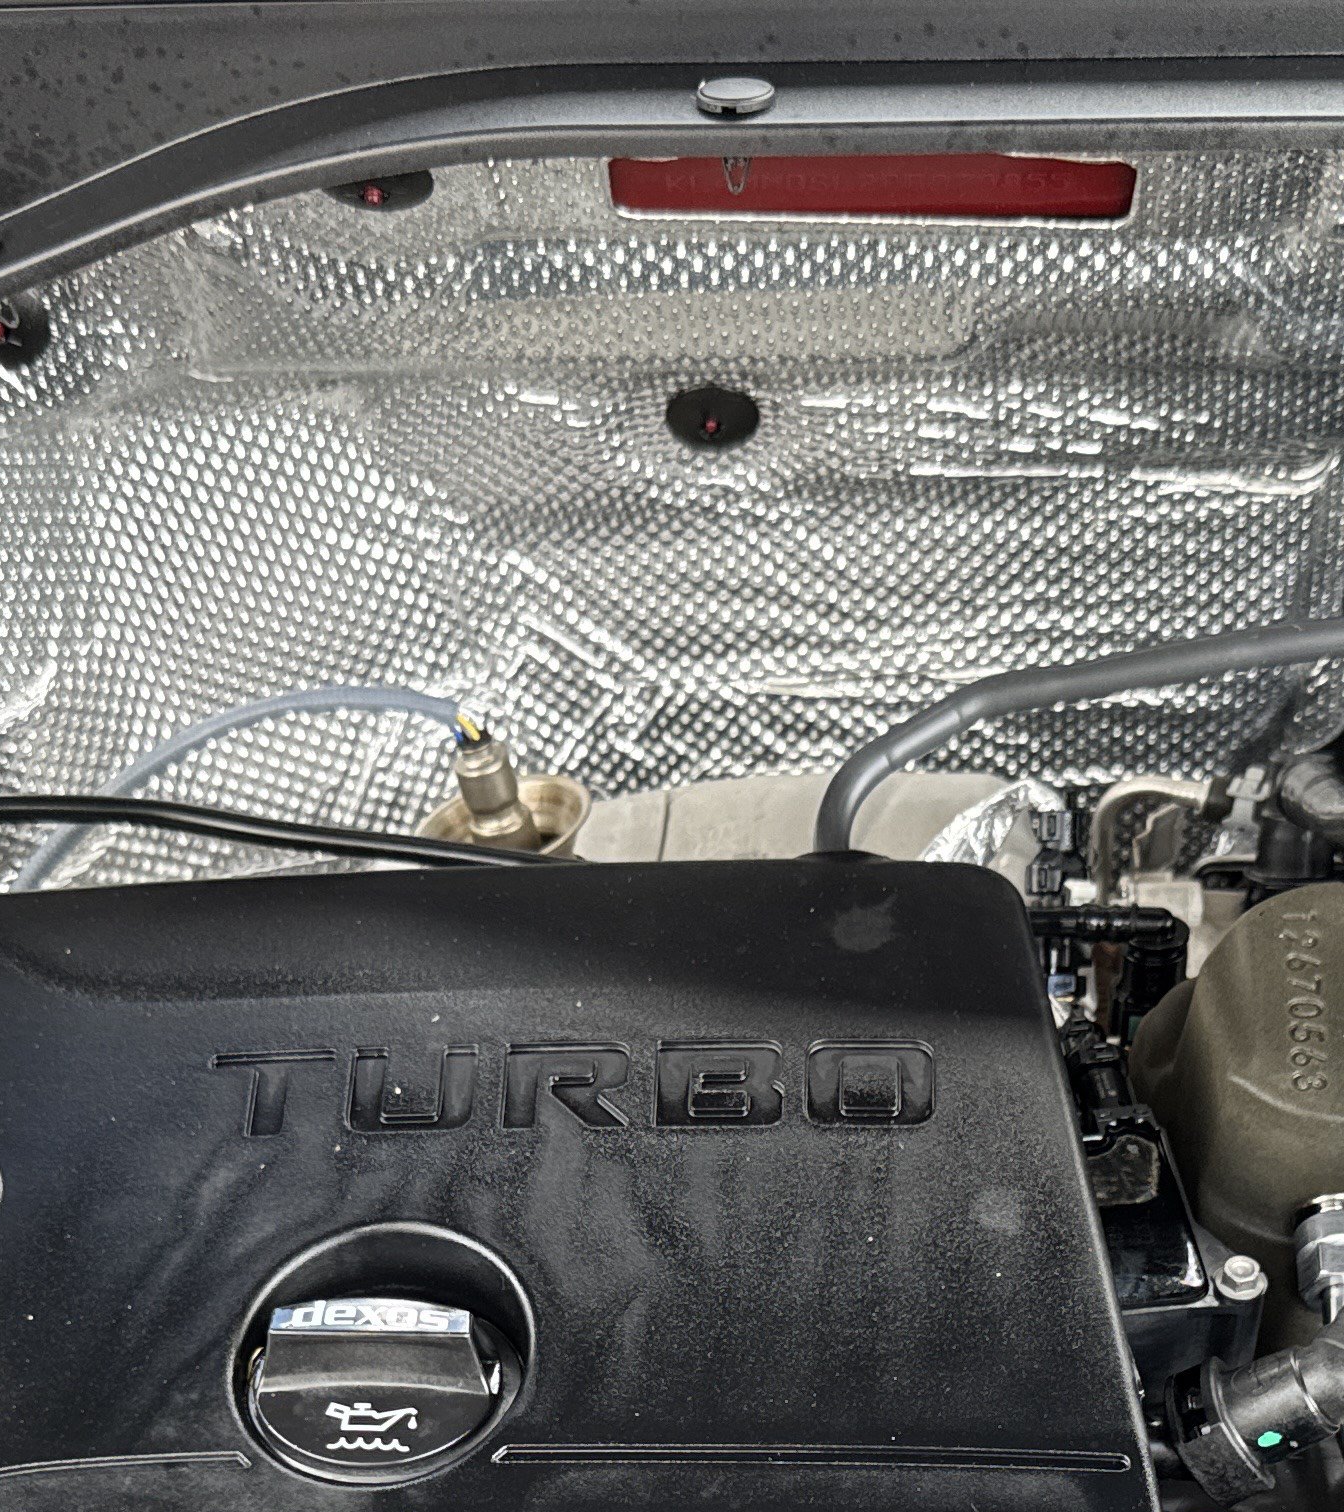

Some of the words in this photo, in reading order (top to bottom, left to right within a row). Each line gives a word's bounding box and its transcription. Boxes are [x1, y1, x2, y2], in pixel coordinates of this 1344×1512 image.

[1278, 907, 1328, 1091] 12670563
[209, 1038, 938, 1137] TURBO
[285, 1299, 452, 1331] dexos
